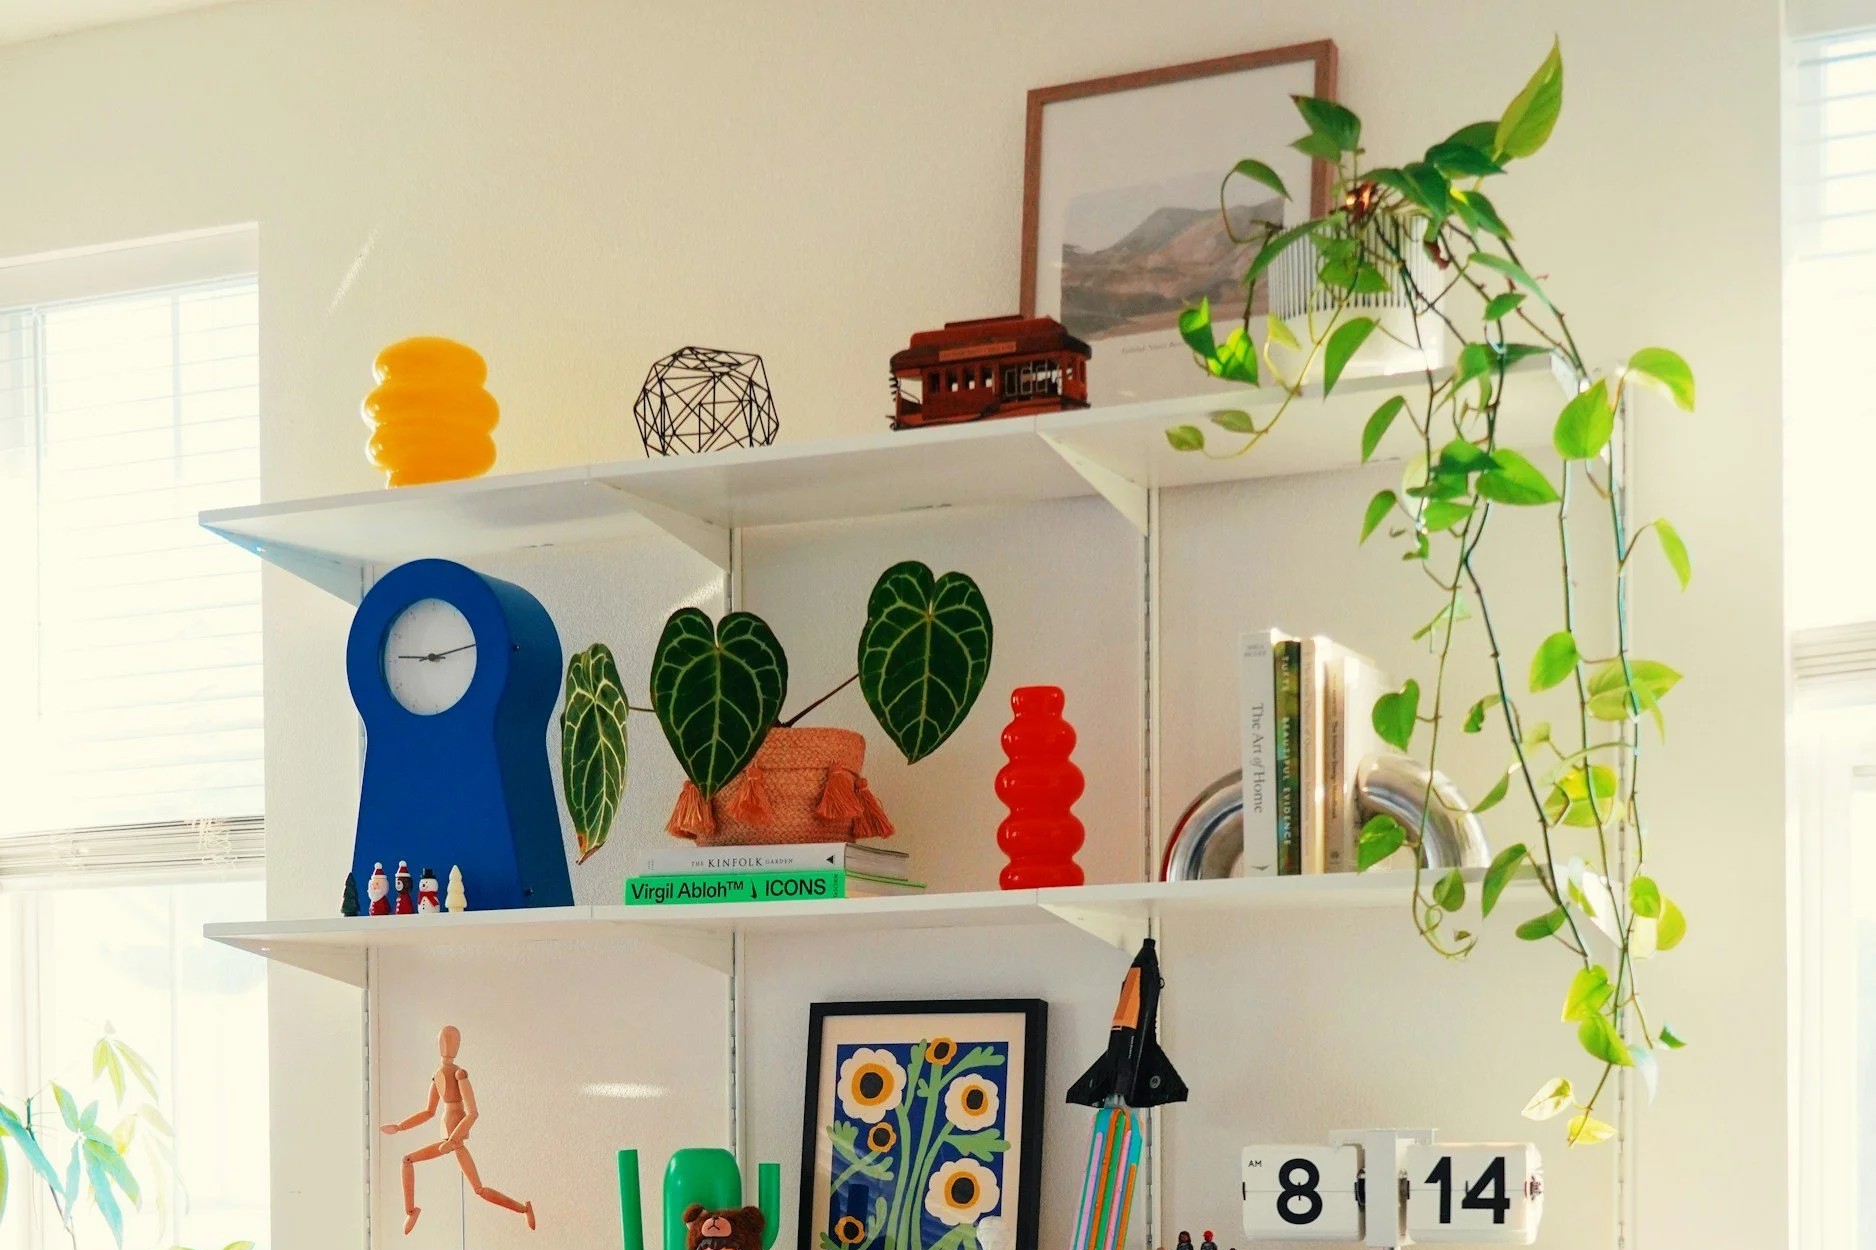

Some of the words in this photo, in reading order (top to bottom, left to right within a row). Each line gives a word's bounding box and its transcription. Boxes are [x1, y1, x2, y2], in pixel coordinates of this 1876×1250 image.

[1251, 703, 1264, 730] The
[1252, 733, 1264, 754] Art
[1250, 757, 1265, 769] of
[1252, 771, 1266, 814] Home
[1282, 787, 1292, 845] EVIDENCE
[708, 857, 763, 868] KINFOLK
[631, 881, 674, 903] Virgil
[765, 878, 826, 897] ICONS
[1248, 1160, 1262, 1168] AM
[1276, 1158, 1323, 1225] 8
[1424, 1156, 1510, 1224] 14
